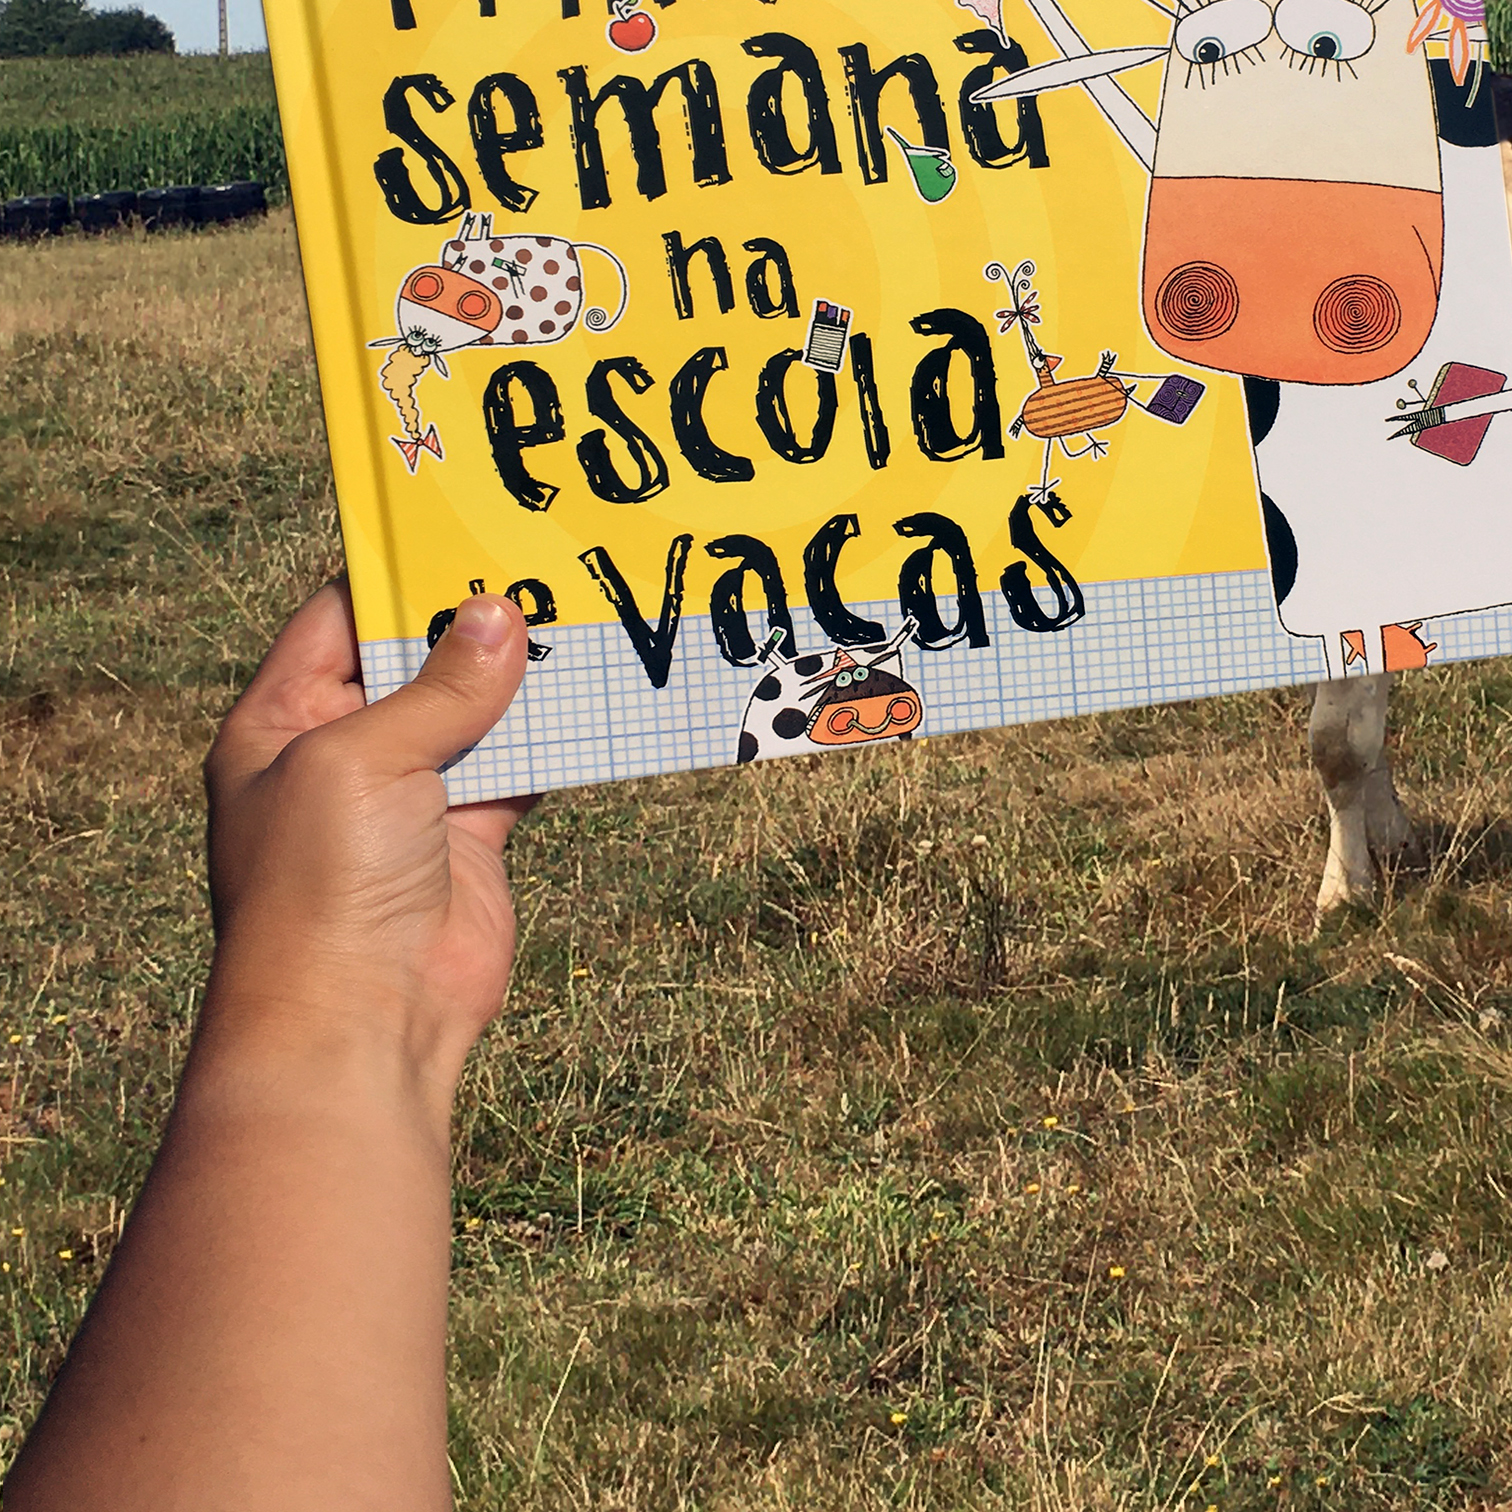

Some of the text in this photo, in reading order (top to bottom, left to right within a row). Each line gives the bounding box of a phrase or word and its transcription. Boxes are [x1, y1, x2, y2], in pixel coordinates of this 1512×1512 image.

[374, 31, 1051, 225] semana
[662, 230, 801, 320] na
[483, 307, 1005, 513] escola
